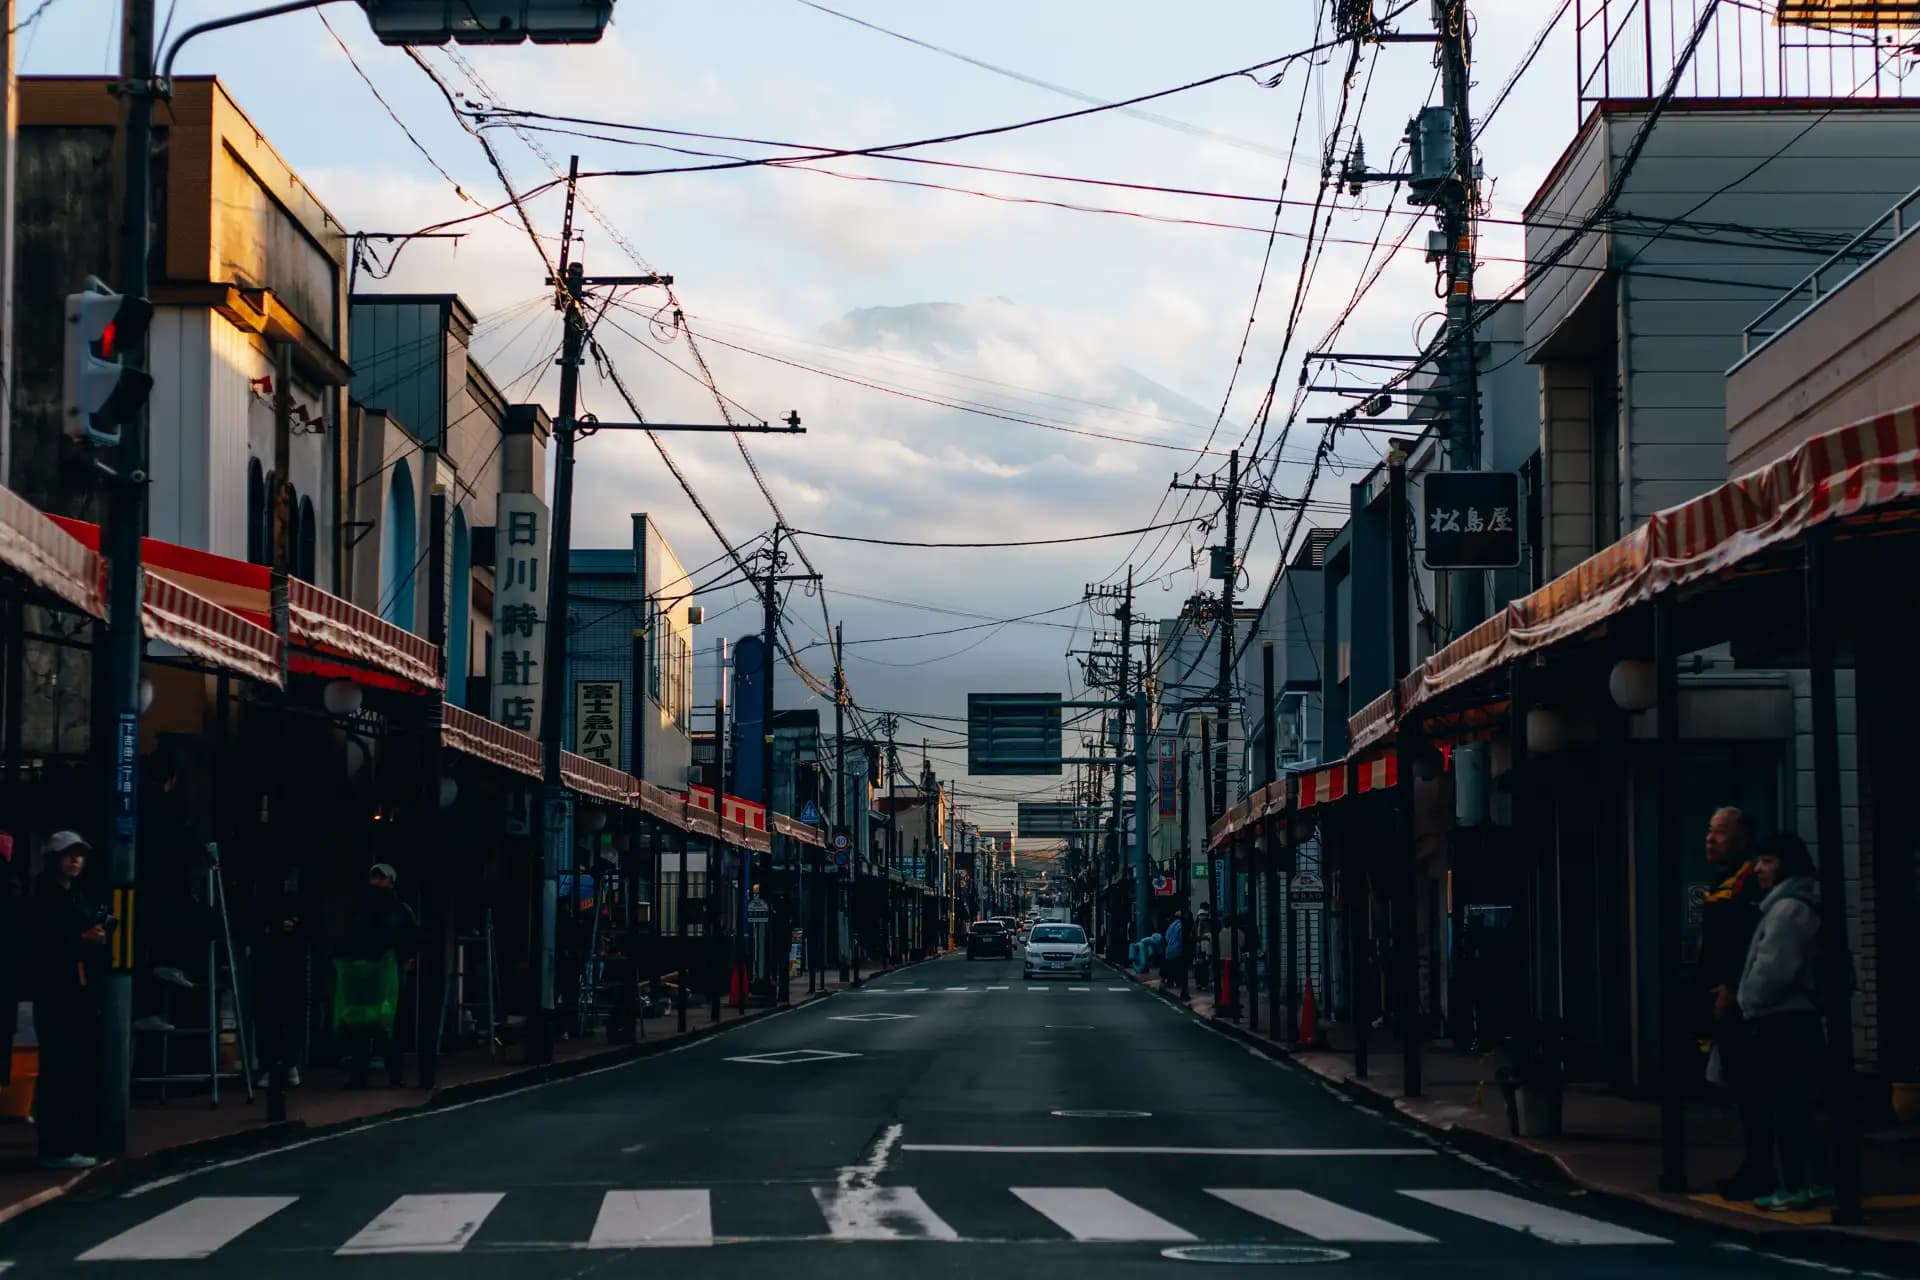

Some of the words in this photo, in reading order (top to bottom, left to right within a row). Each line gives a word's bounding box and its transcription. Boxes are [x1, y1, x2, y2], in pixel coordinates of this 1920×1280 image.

[1429, 506, 1513, 533] 松島屋
[501, 511, 538, 732] 日川時計店
